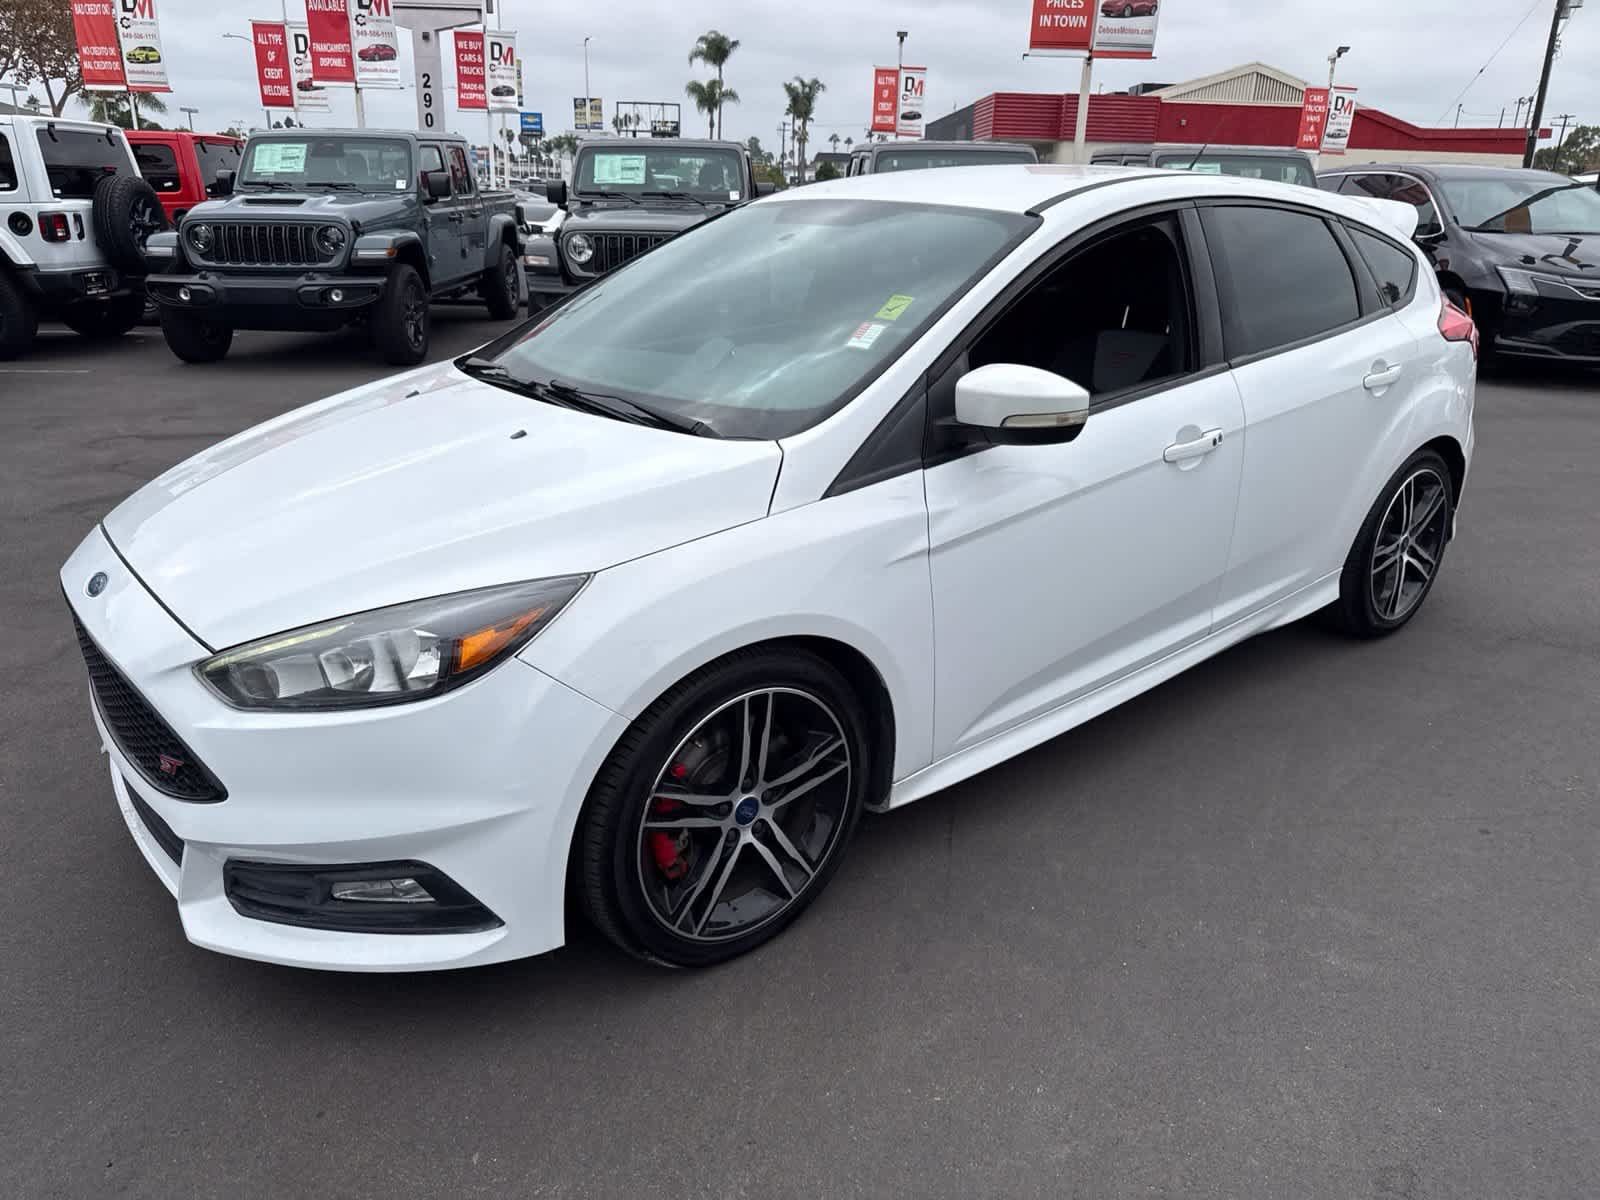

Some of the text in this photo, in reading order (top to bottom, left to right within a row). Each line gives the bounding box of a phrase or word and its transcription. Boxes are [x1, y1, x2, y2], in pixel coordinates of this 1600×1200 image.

[308, 0, 345, 12] AVAILABLE
[1046, 0, 1084, 8] PRICES
[1040, 15, 1088, 28] IN TOWN
[257, 33, 283, 45] ALL TYPE
[457, 41, 482, 50] WE BUY
[267, 50, 276, 62] OF
[459, 53, 477, 62] CARS
[264, 67, 284, 79] CREDIT
[460, 65, 484, 76] TRUCKS
[263, 84, 290, 97] WELCOME
[422, 73, 434, 127] 290
